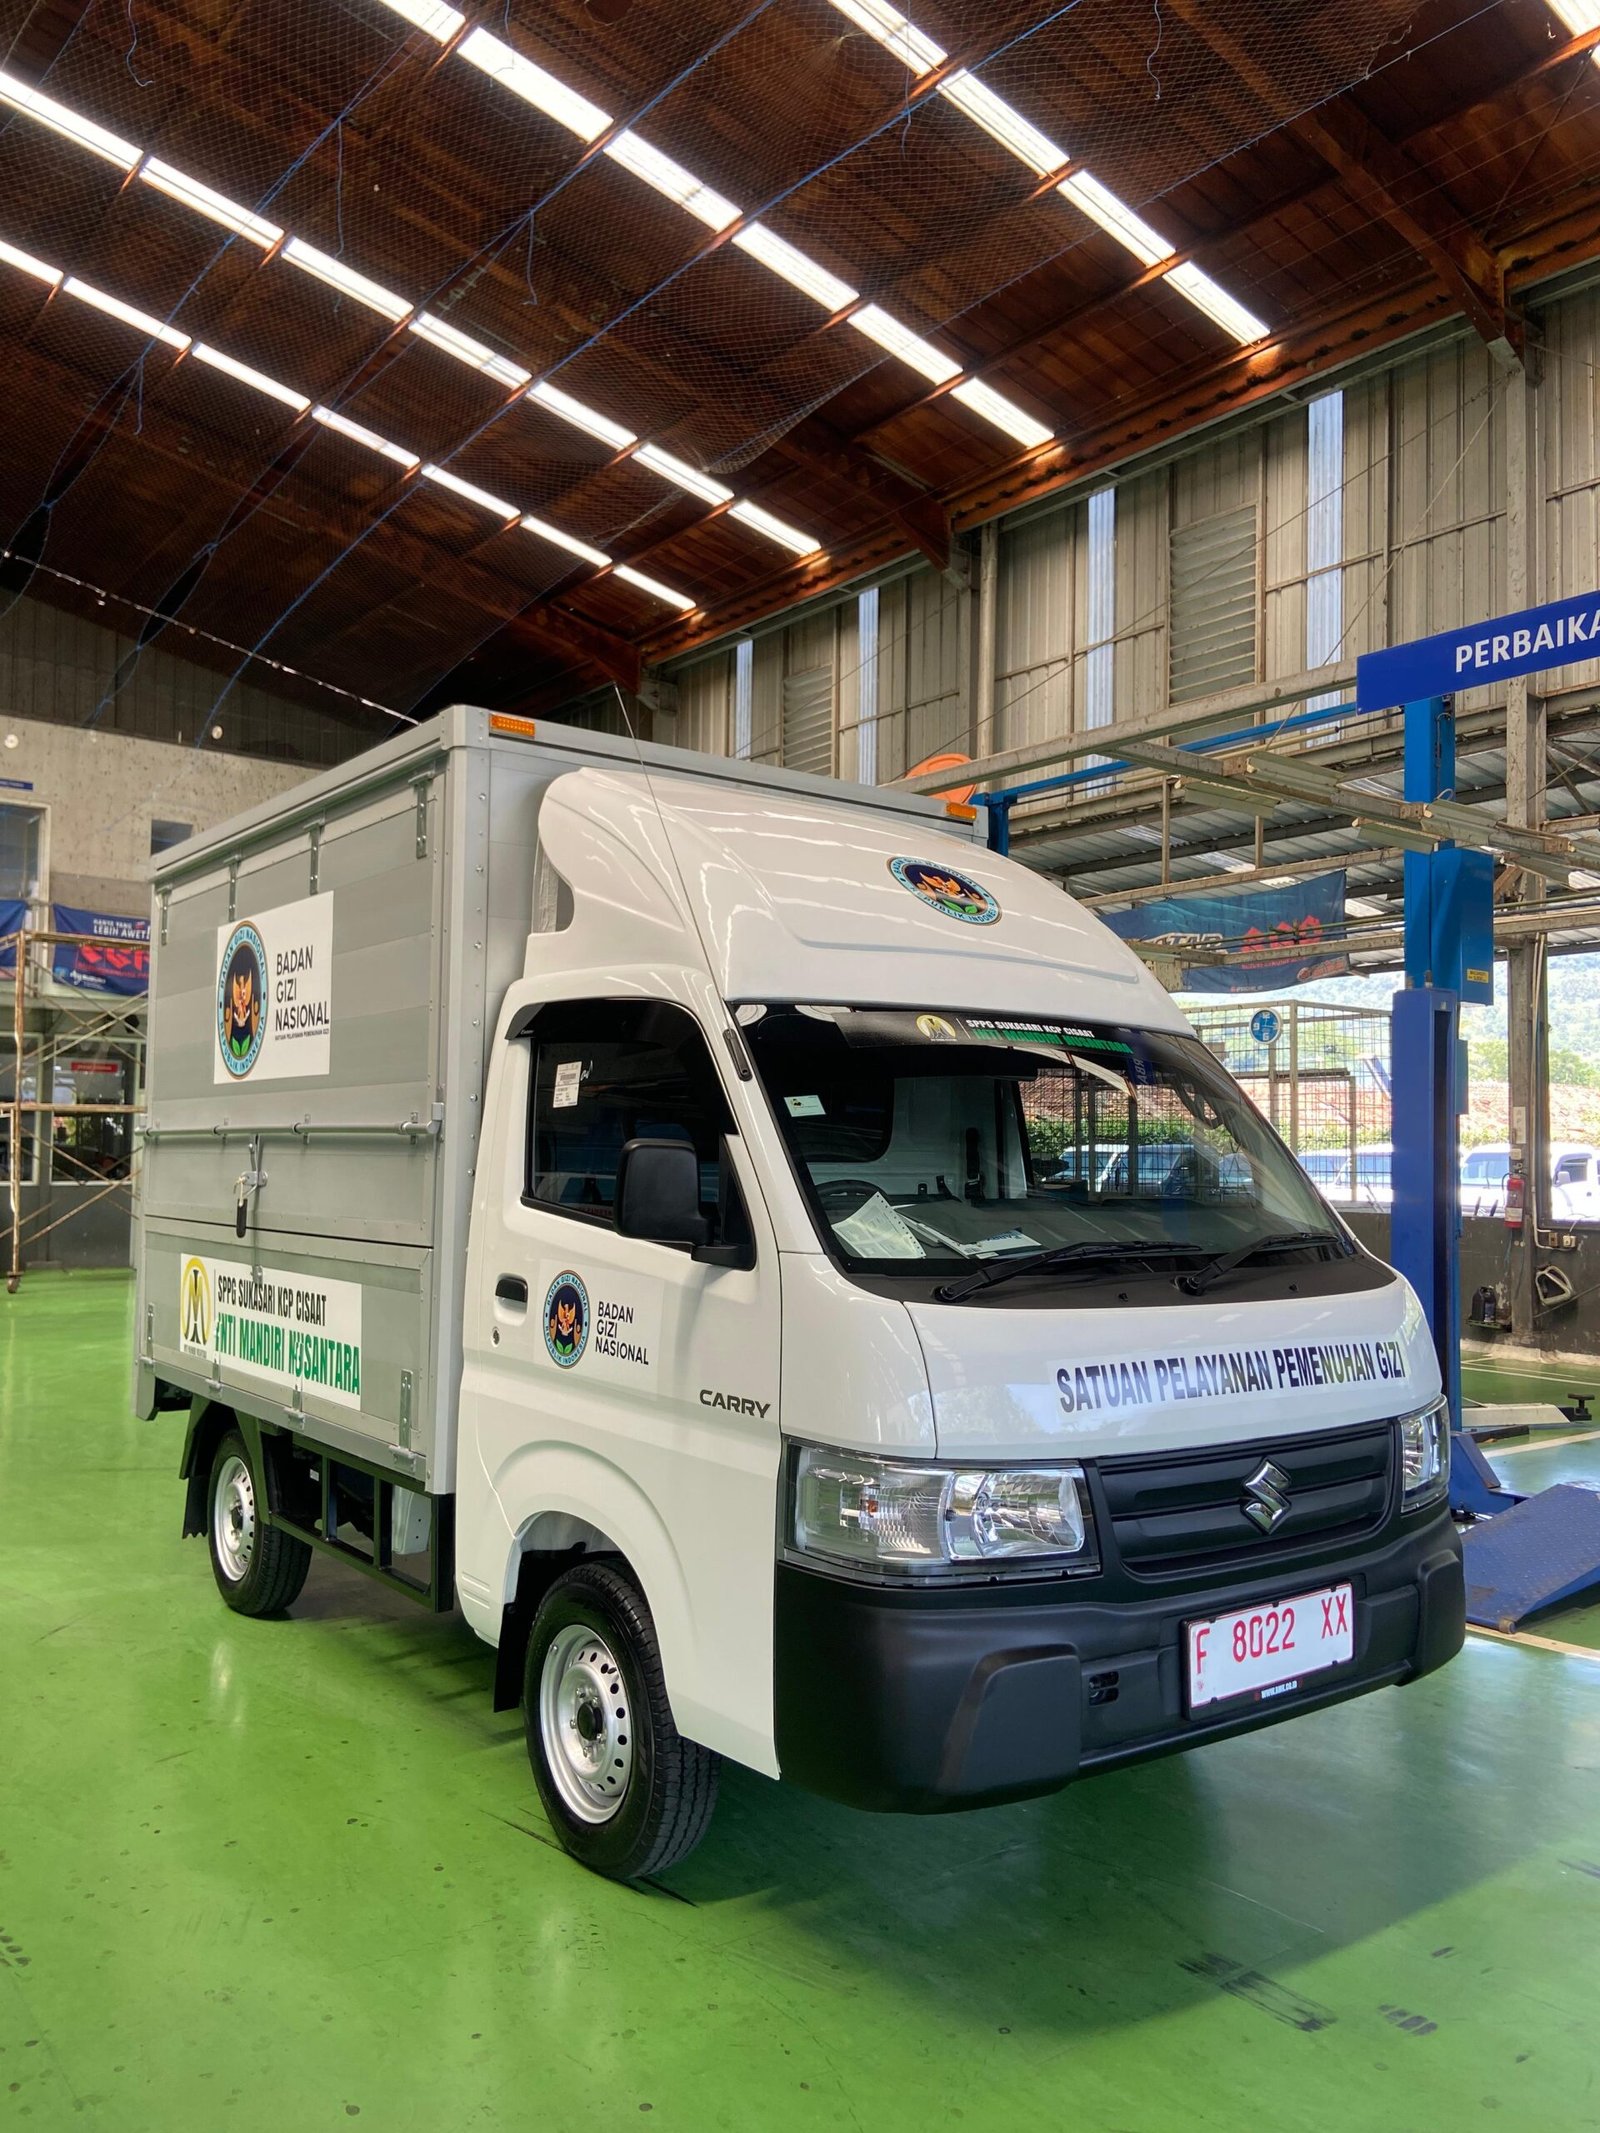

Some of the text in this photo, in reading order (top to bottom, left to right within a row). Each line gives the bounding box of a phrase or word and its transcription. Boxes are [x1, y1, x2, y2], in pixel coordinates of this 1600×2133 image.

[276, 945, 313, 976] BADAN
[276, 977, 297, 1003] GIZI
[275, 1001, 329, 1032] NASIONAL
[966, 1019, 994, 1029] SPPG
[994, 1020, 1043, 1032] SUKASARI
[1043, 1024, 1062, 1034] KCP
[218, 1274, 327, 1327] SPPG SUKASARI KCP CISAAT
[597, 1301, 634, 1324] BADAN
[597, 1320, 618, 1339] GIZI
[239, 1317, 285, 1372] MANDIRI
[288, 1329, 361, 1395] NUSANTARA
[595, 1336, 649, 1366] NASIONAL
[1056, 1341, 1406, 1413] SATUAN PELAYANAN PEMENUHAN GIZI
[700, 1389, 771, 1419] CARRY
[1196, 1593, 1348, 1674] F 8022 XX
